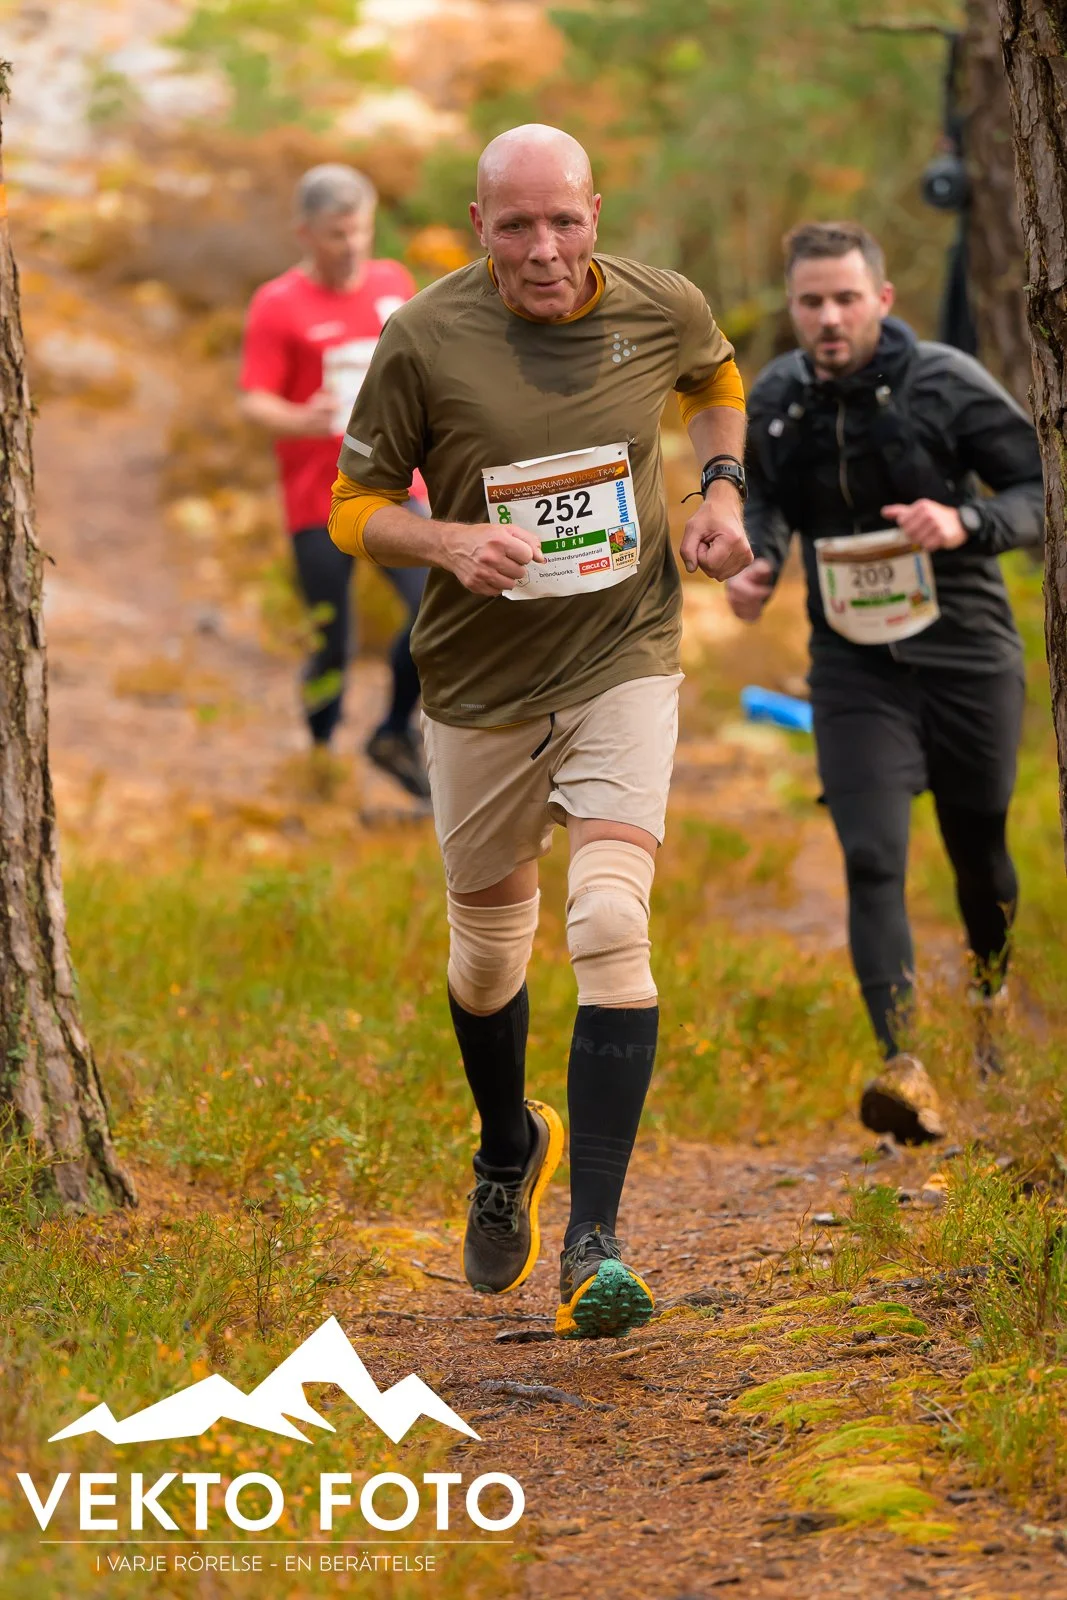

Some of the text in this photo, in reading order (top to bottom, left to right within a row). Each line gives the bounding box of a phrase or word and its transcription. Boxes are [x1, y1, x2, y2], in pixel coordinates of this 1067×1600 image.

[534, 490, 593, 526] 252
[615, 480, 629, 523] Aktivitus
[555, 525, 580, 538] Per
[555, 537, 584, 549] 10 KM
[581, 561, 599, 571] CIRCLE
